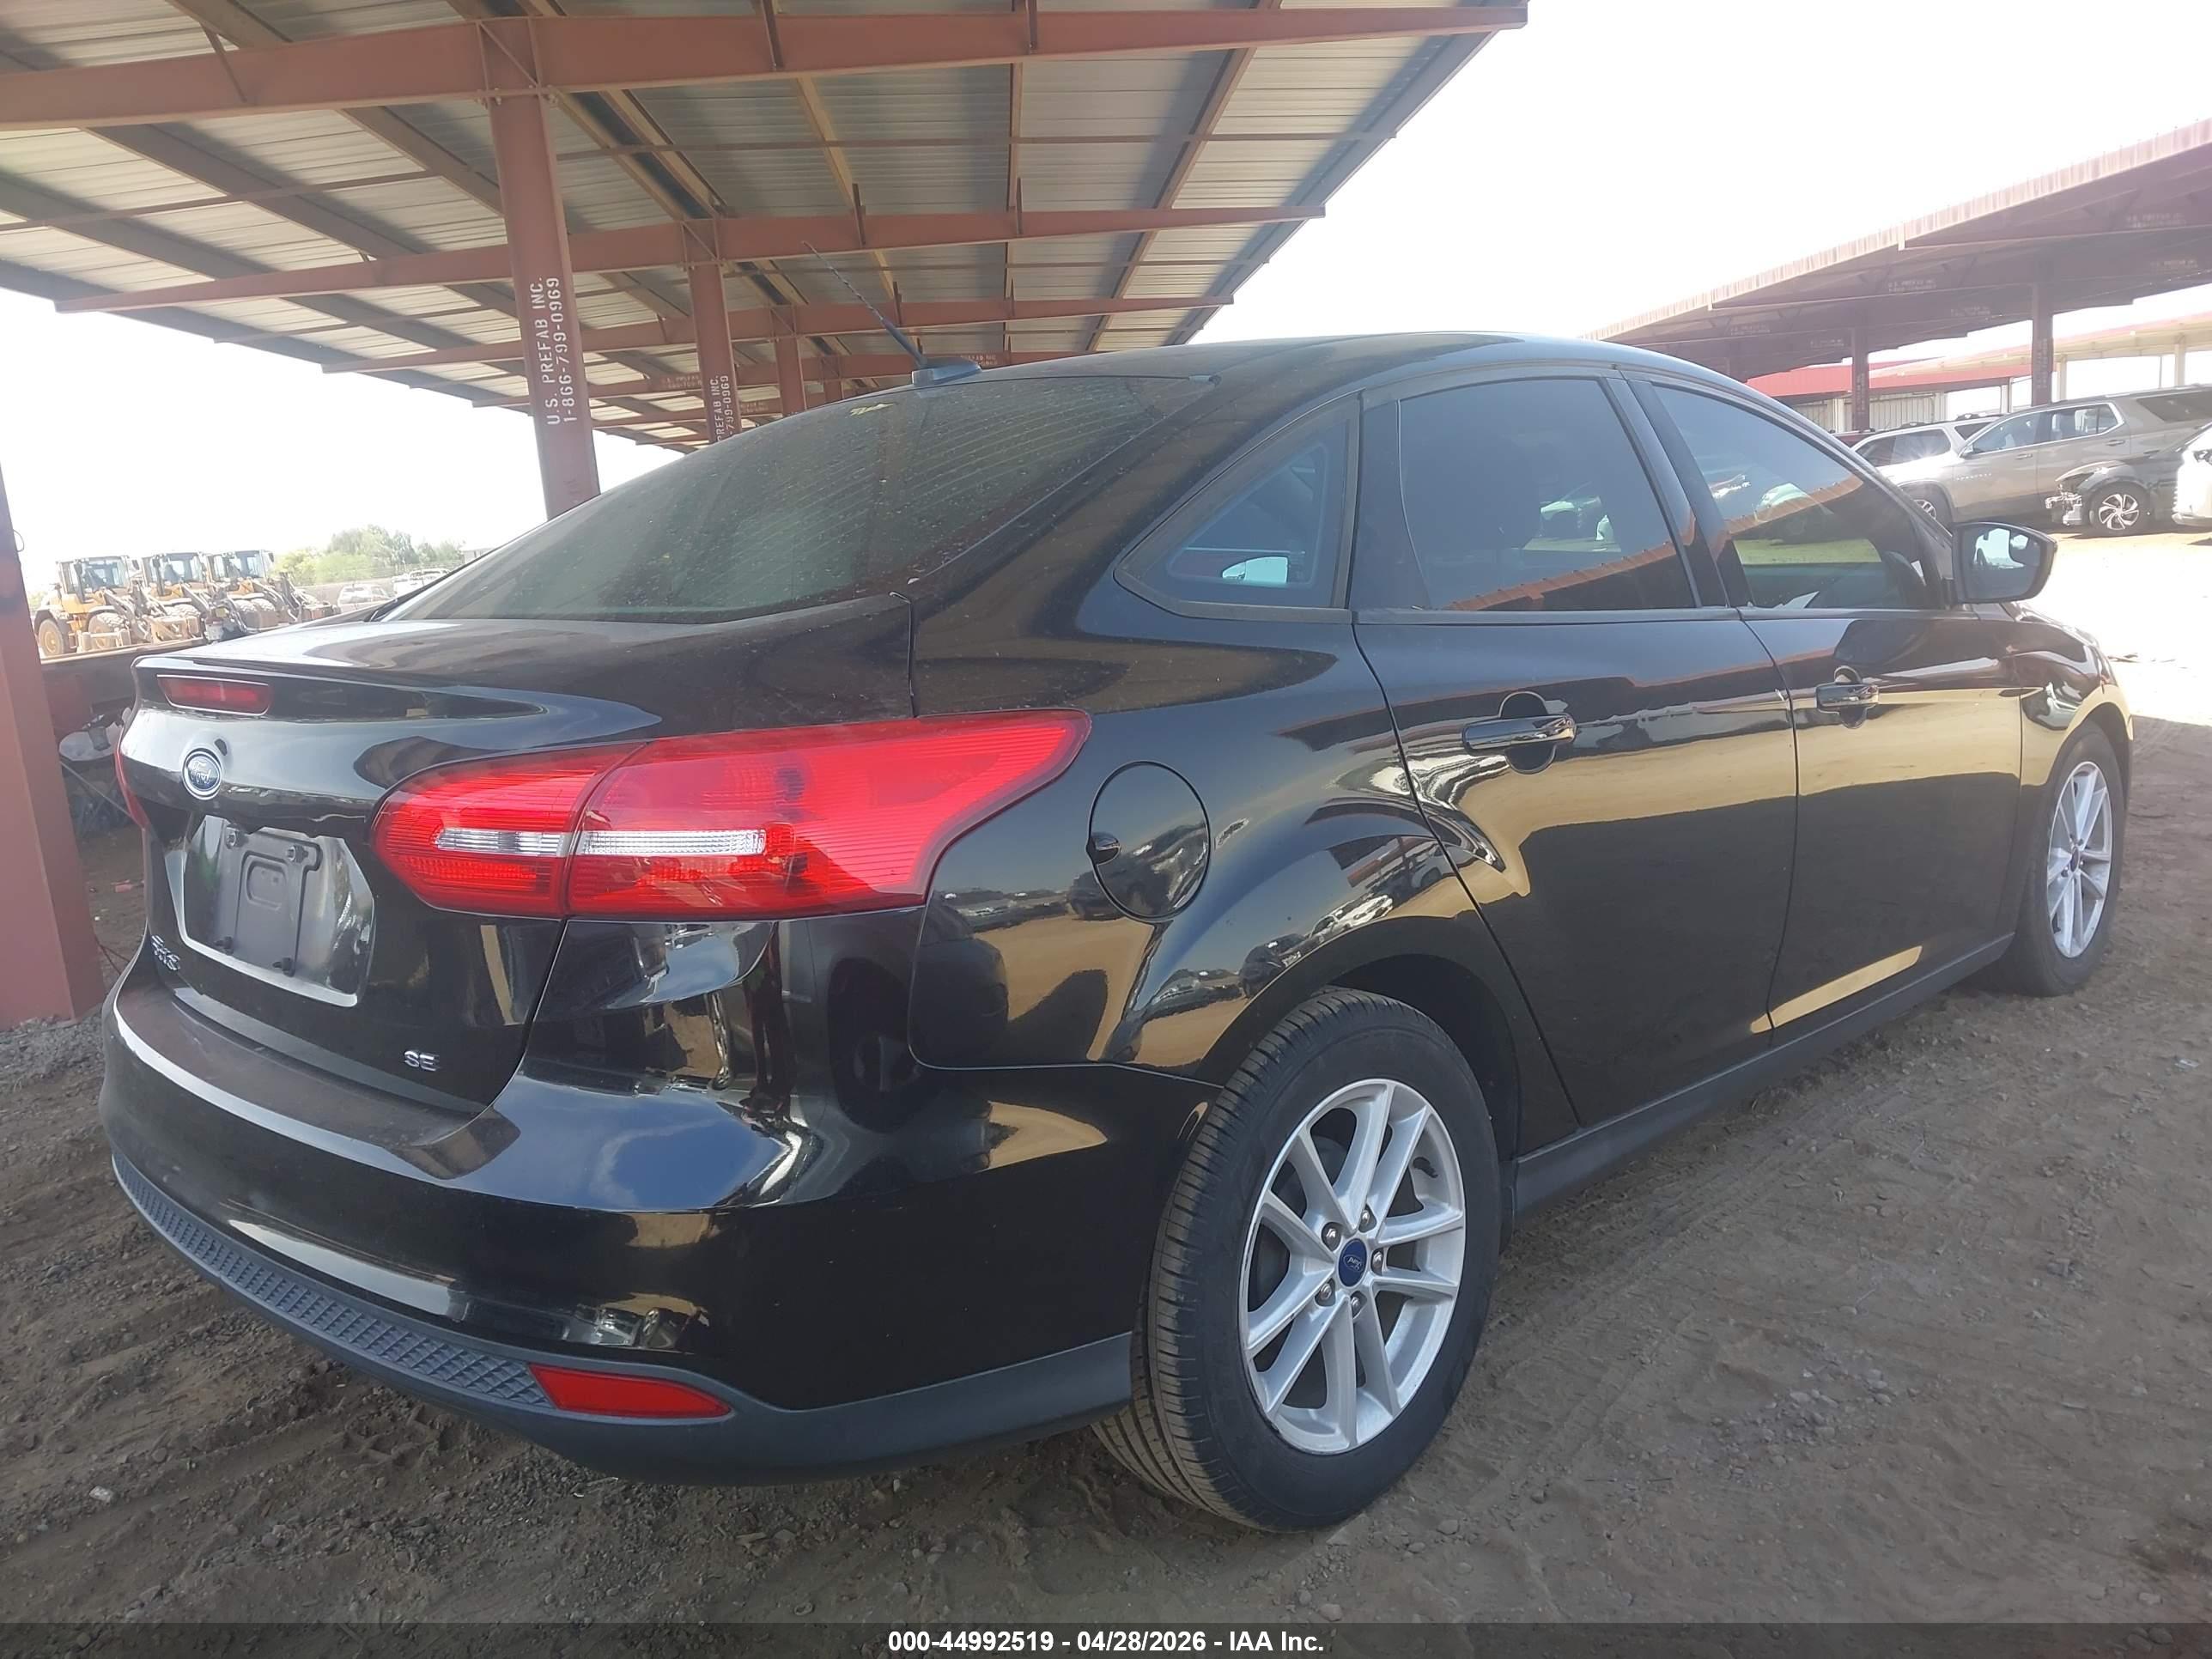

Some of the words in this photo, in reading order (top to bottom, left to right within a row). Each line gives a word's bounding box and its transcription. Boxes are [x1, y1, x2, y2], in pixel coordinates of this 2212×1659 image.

[529, 276, 546, 310] INC.
[534, 319, 556, 383] PREFAB
[545, 277, 578, 422] 1-866-799-0969
[709, 375, 720, 396] INC.
[544, 392, 562, 425] U.S.
[404, 1050, 437, 1072] SE
